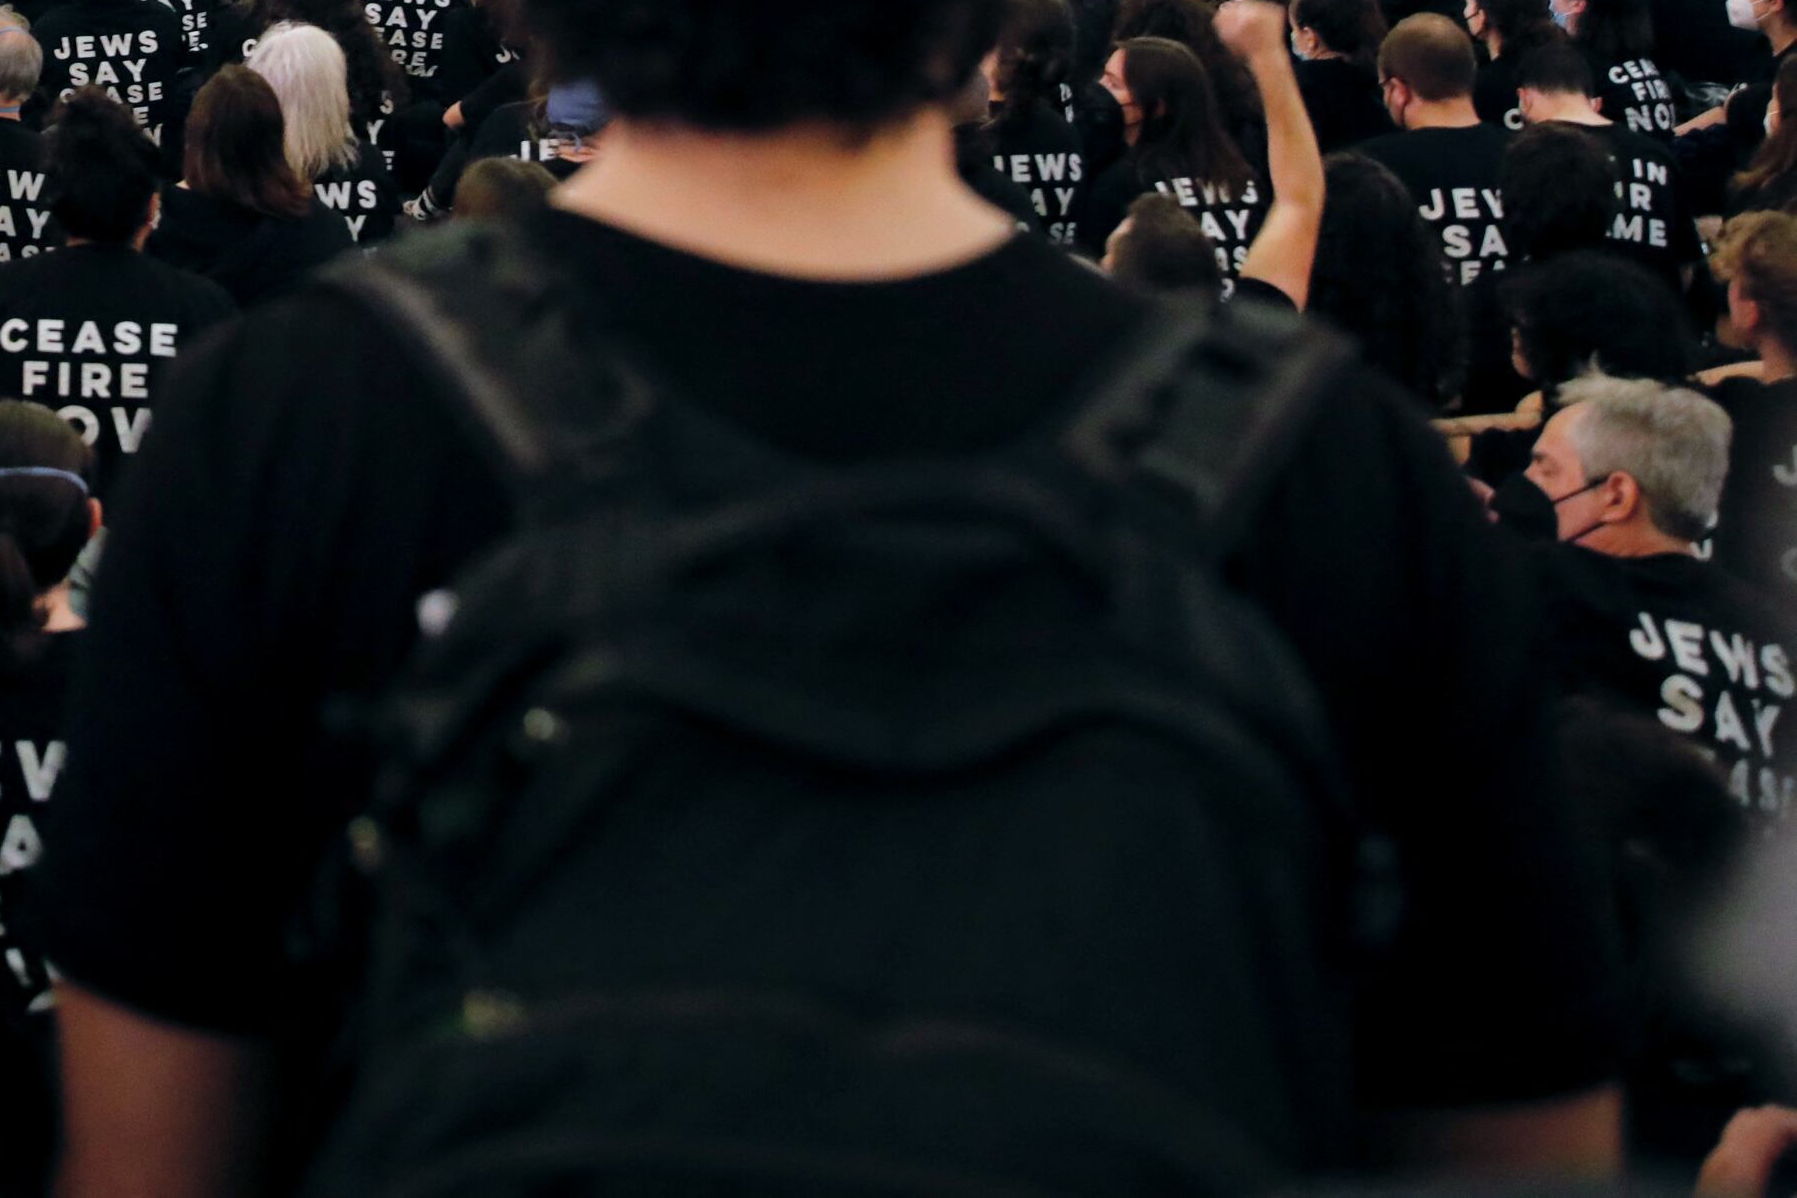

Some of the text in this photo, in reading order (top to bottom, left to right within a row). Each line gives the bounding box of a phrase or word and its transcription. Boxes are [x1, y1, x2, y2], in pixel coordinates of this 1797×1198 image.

[364, 2, 438, 31] SAY
[53, 29, 160, 60] JEWS
[373, 26, 444, 51] ASE
[68, 58, 148, 87] SAY
[391, 48, 428, 67] RE
[1608, 56, 1661, 85] CEA
[59, 80, 163, 105] CASE
[1631, 78, 1673, 102] FIR
[1624, 103, 1676, 132] NO
[1632, 157, 1668, 187] IN
[315, 179, 377, 210] WS
[1030, 187, 1074, 217] AY
[1418, 187, 1504, 221] JE
[1200, 209, 1250, 242] AY
[1606, 213, 1669, 248] ME
[1441, 224, 1508, 259] SA
[0, 317, 179, 358] CEASE
[21, 359, 149, 399] FIRE
[54, 404, 154, 454] OW
[1628, 611, 1796, 698] JEWS
[1656, 672, 1781, 759] SAY
